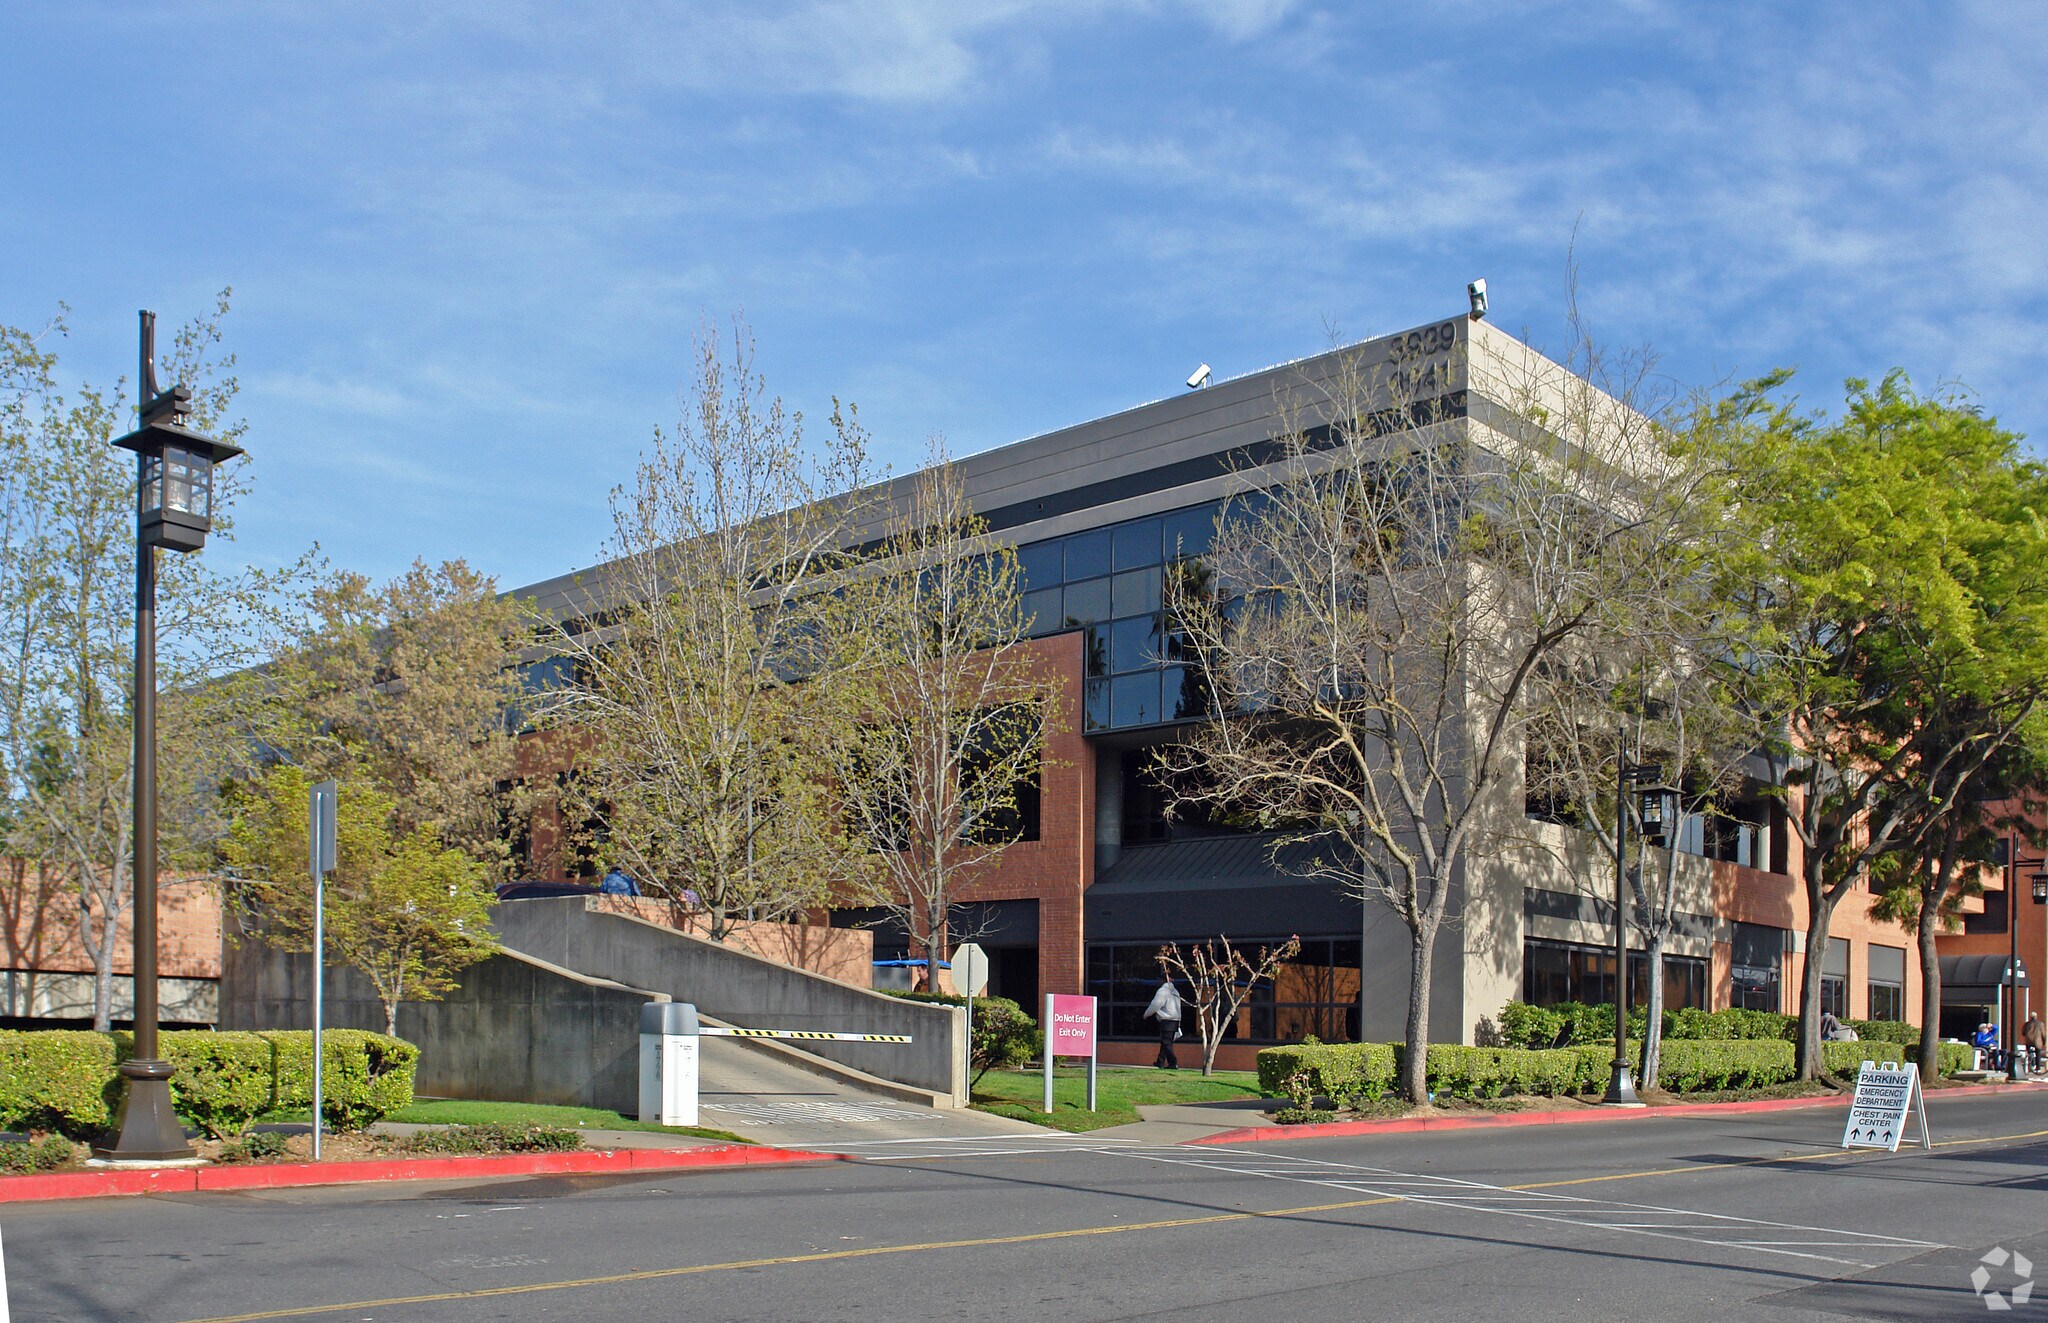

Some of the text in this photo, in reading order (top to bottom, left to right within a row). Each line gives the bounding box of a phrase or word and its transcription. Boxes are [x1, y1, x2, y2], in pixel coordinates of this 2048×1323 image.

[1390, 321, 1457, 365] 3939
[1055, 1013, 1091, 1023] Do Not Enter
[1059, 1028, 1087, 1040] Exit Only
[1861, 1074, 1909, 1085] PARKING
[1860, 1087, 1905, 1097] EMERGENCY
[1856, 1097, 1904, 1107] DEPARTMENT
[1853, 1110, 1880, 1118] CHEST
[1858, 1119, 1891, 1127] CENTER
